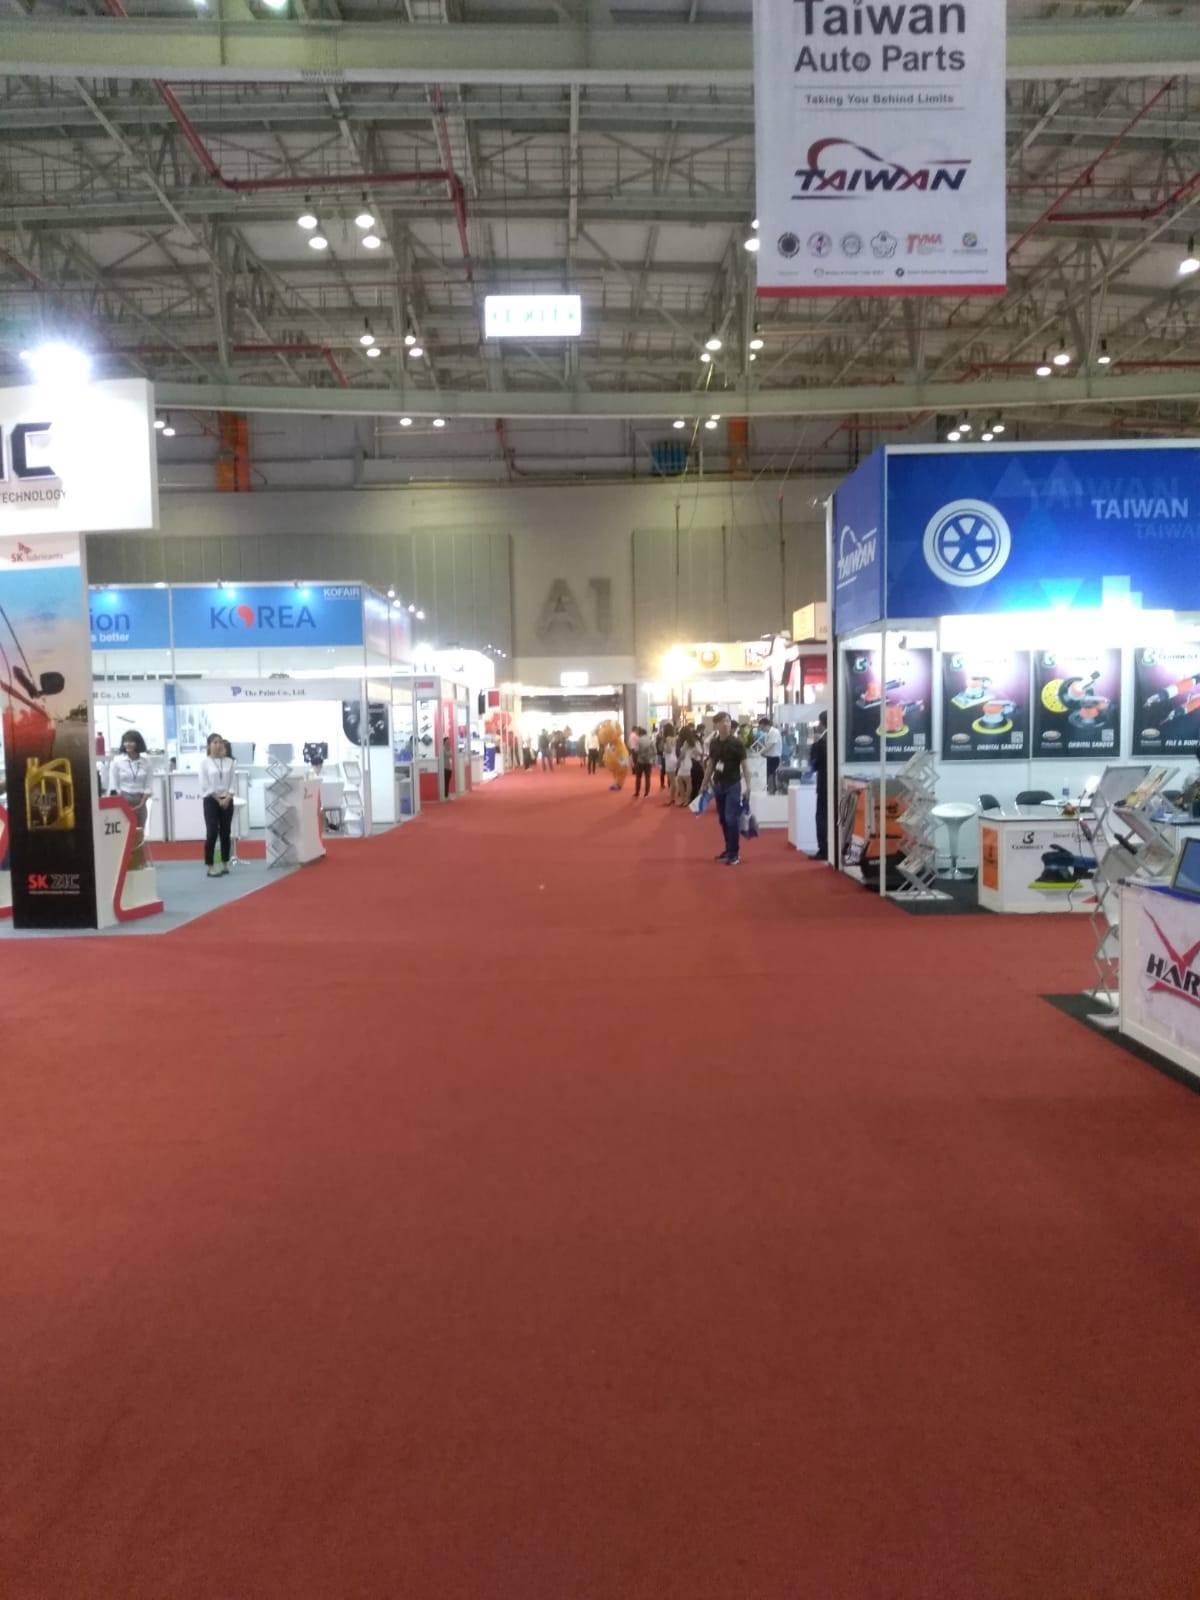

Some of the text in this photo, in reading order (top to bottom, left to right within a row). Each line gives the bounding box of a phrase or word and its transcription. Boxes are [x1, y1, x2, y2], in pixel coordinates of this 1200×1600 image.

[793, 0, 966, 36] Taiwan
[794, 45, 966, 72] Auto Parts
[806, 93, 955, 106] Taking You Behind Limits
[794, 168, 967, 191] TAIWAN
[1091, 498, 1188, 519] TAIWAN
[323, 587, 360, 597] KOFAIR
[210, 604, 317, 630] KOREA
[535, 578, 612, 642] A1
[100, 633, 130, 643] better
[105, 821, 121, 835] ZIC
[28, 874, 48, 889] SK
